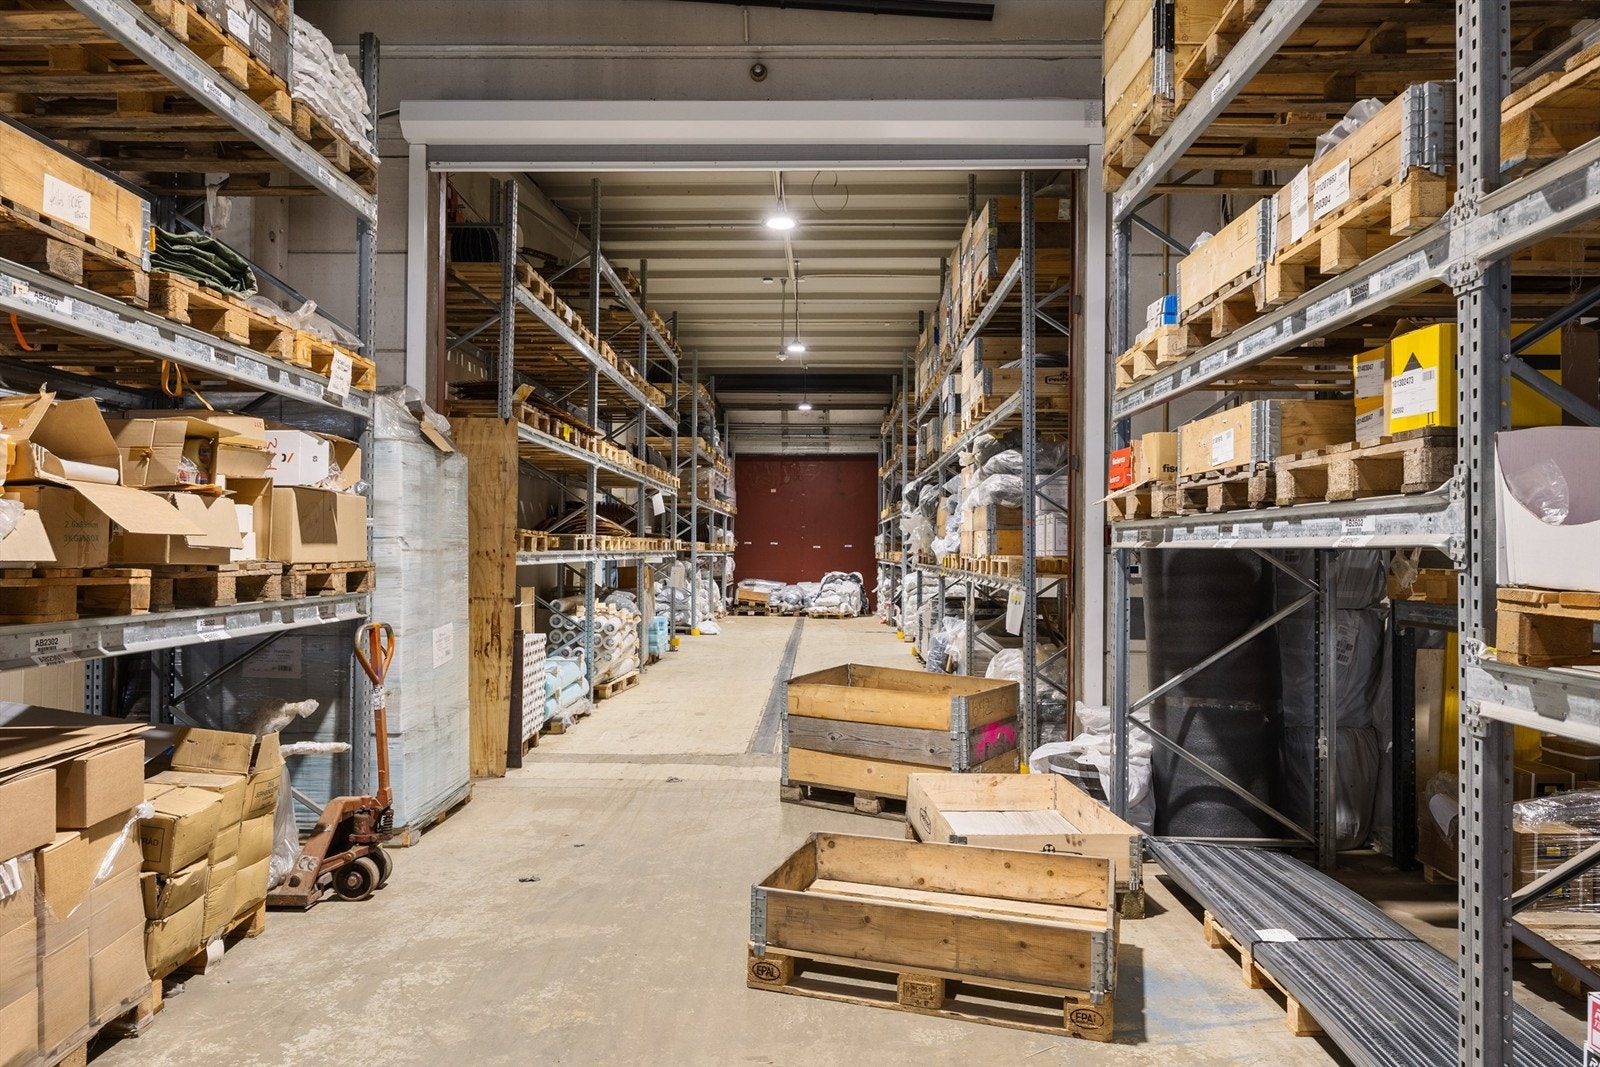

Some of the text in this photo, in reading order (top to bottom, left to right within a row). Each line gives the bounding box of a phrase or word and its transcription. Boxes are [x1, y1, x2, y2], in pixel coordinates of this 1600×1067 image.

[34, 290, 59, 306] AB2303
[35, 637, 59, 648] AB2302
[298, 856, 318, 872] CE
[756, 965, 777, 978] EPAL
